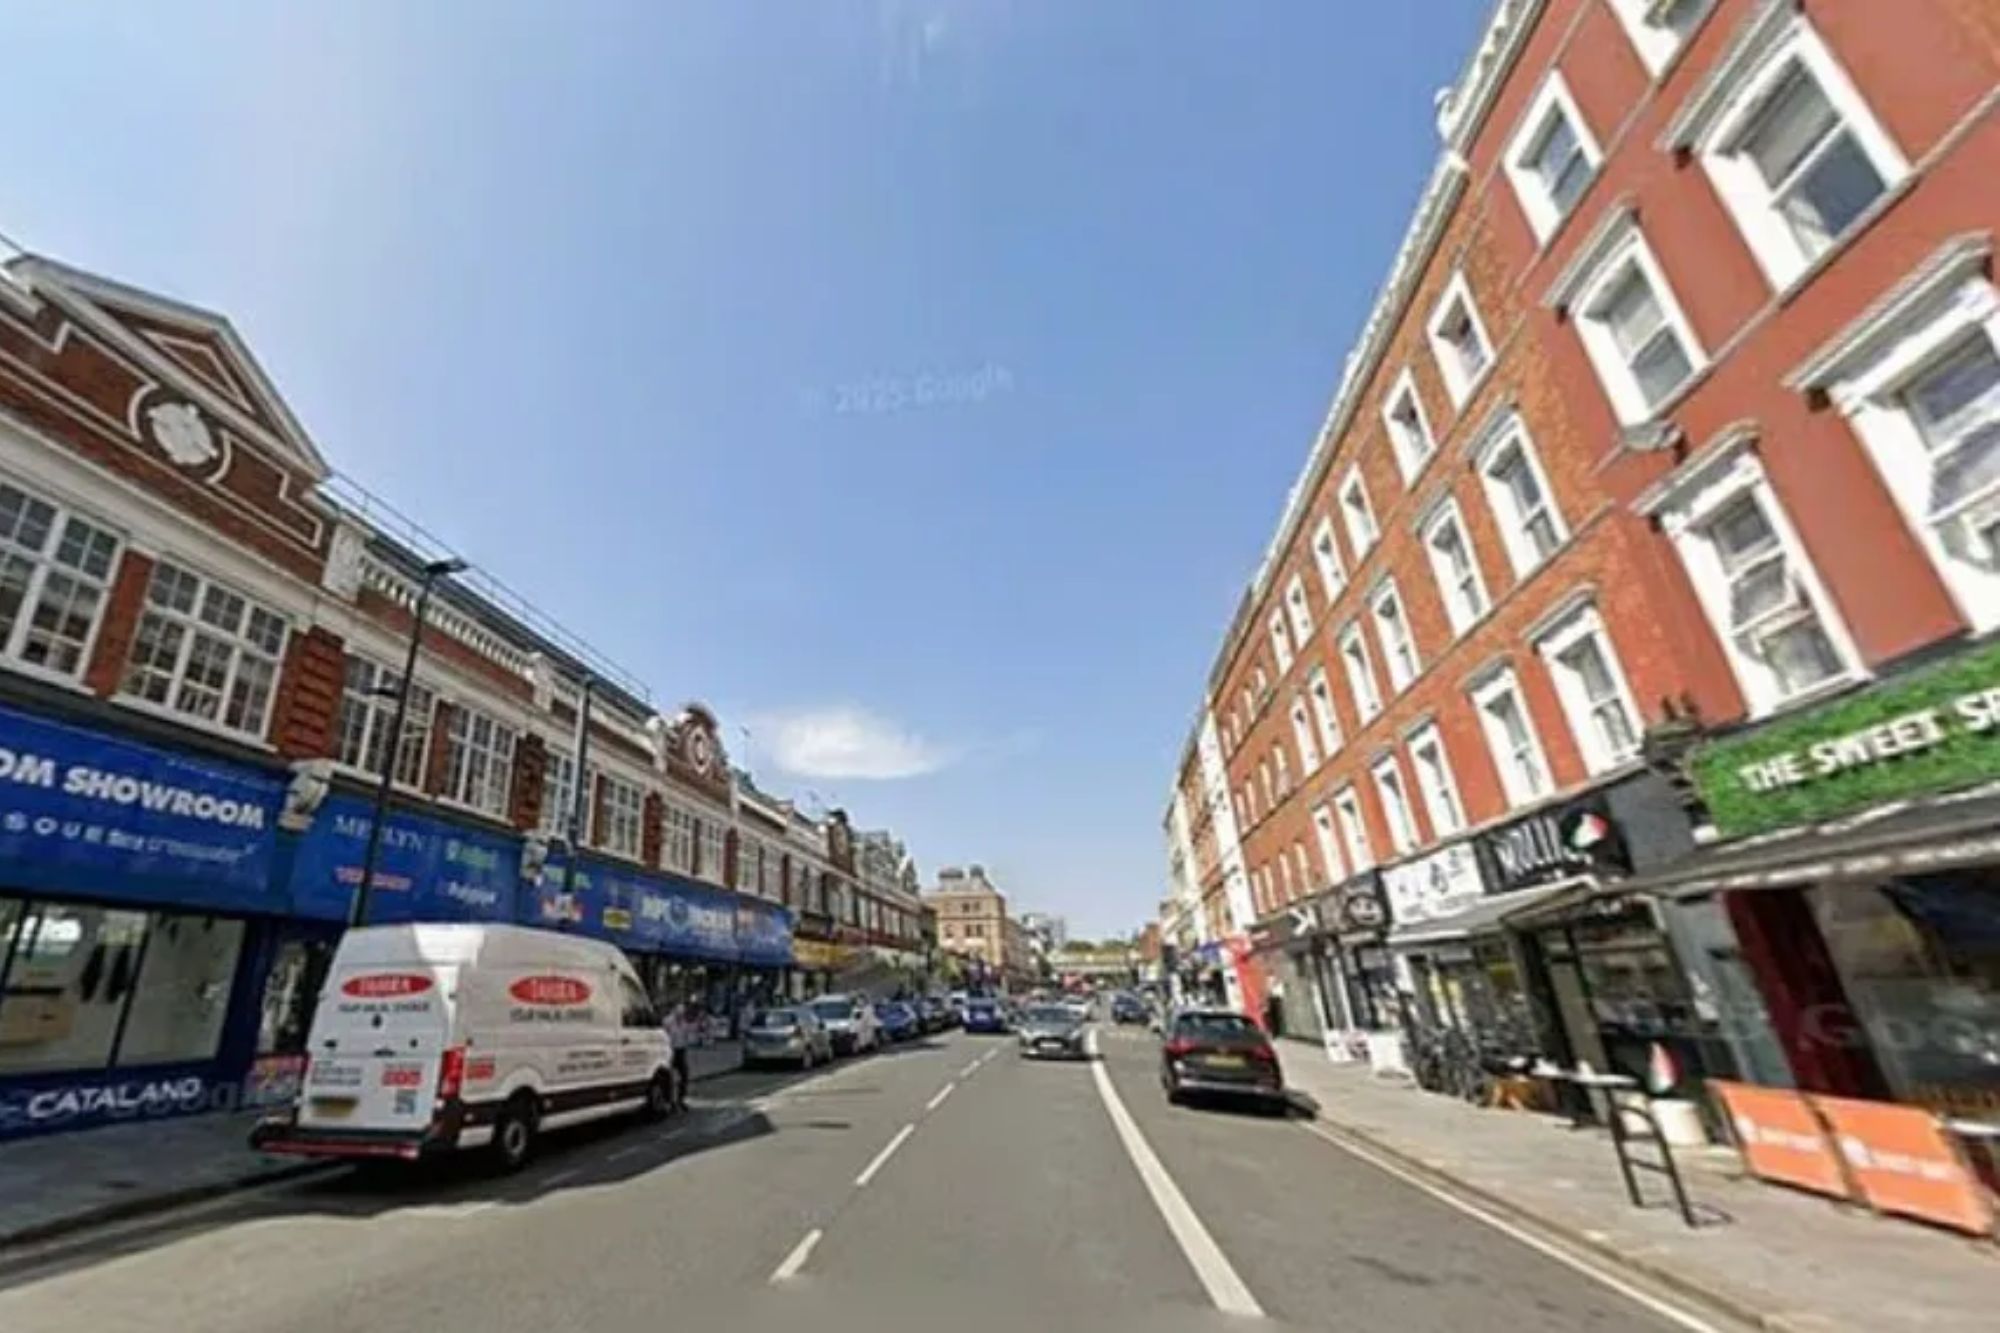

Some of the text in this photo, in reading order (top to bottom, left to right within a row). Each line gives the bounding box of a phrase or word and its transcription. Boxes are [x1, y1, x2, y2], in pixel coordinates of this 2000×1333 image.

[1738, 752, 1806, 792] THE
[1808, 708, 1945, 774] SWEET
[62, 766, 265, 830] SHOWROOM
